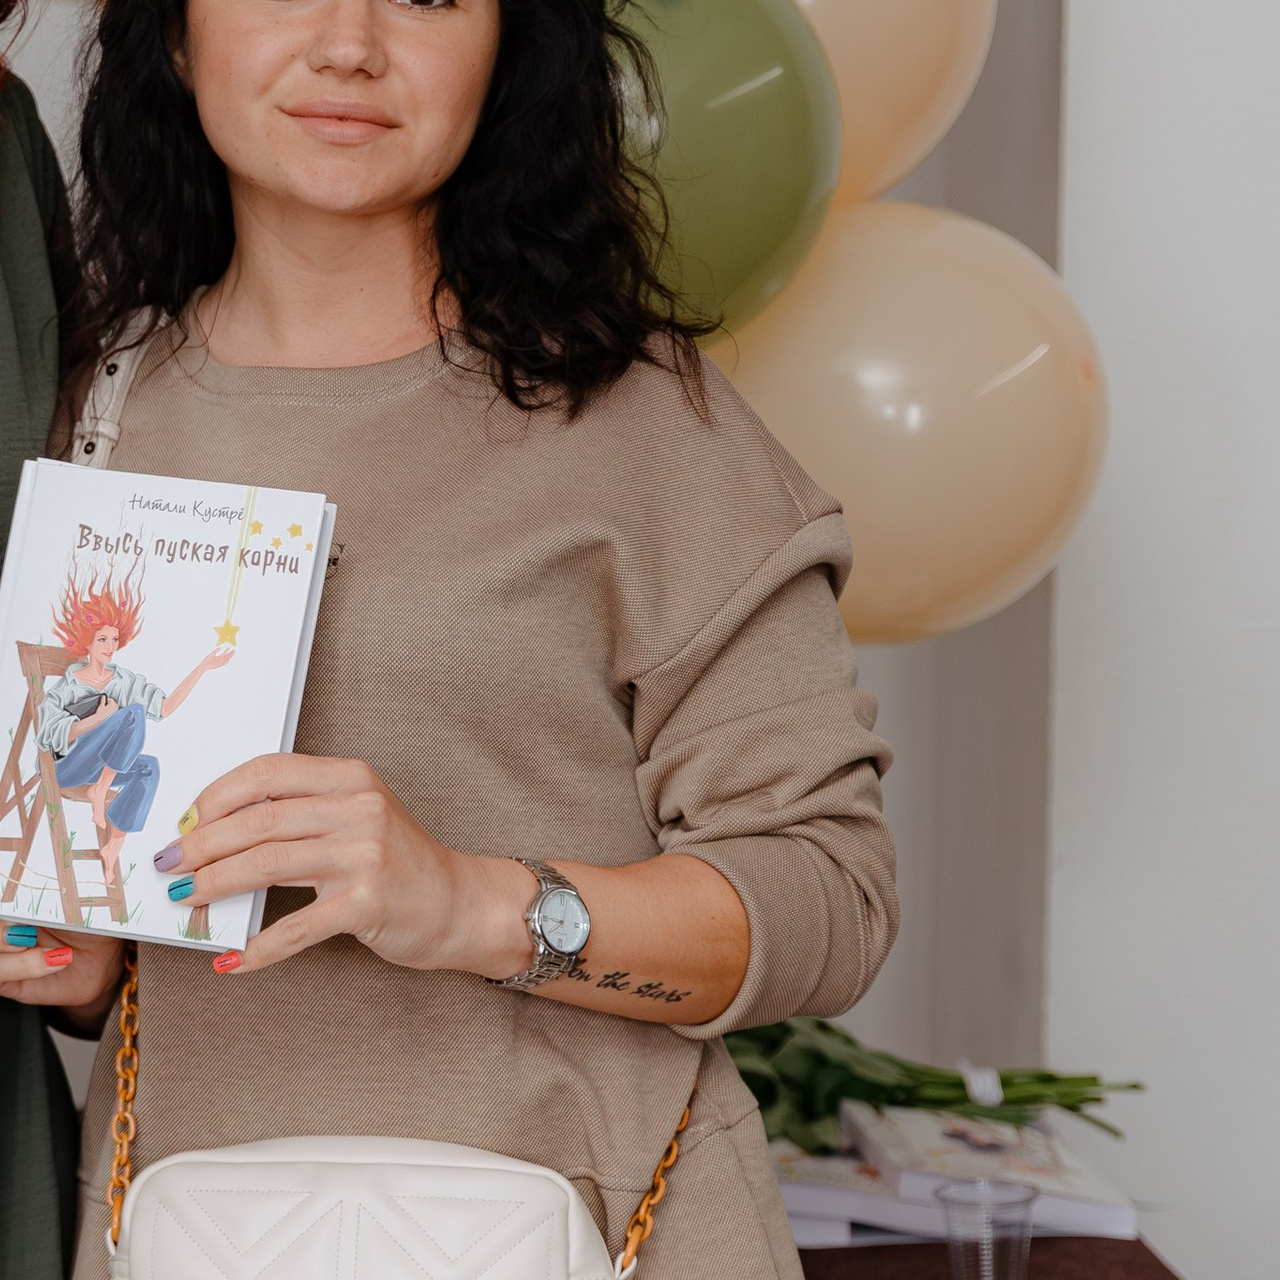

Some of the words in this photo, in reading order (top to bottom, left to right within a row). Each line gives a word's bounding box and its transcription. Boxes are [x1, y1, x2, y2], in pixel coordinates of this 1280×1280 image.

[128, 493, 186, 514] Натали
[76, 523, 144, 557] Ввысь
[154, 538, 230, 564] пуская
[237, 546, 300, 576] корни
